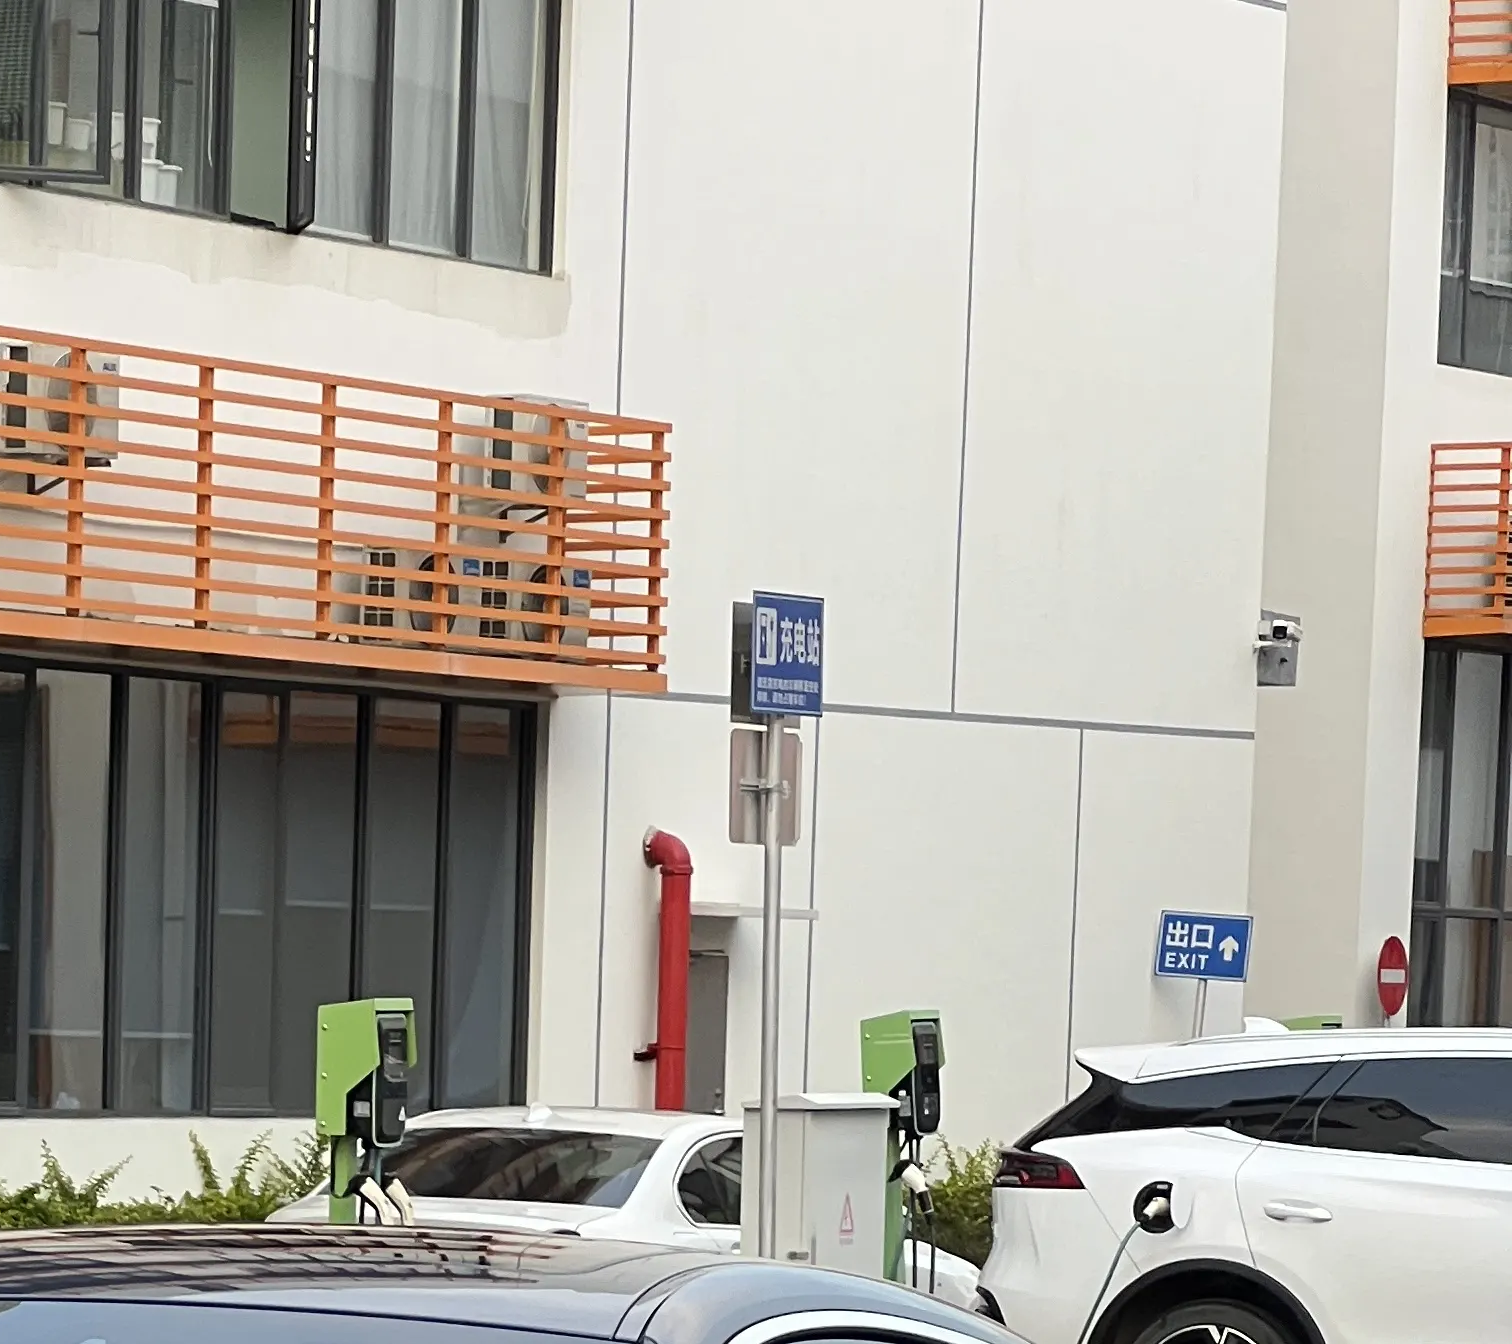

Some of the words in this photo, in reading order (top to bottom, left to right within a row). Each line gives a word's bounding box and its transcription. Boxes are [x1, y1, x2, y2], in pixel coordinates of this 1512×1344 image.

[780, 616, 820, 666] 充电站
[1165, 920, 1214, 949] 出口
[1164, 952, 1209, 970] EXIT
